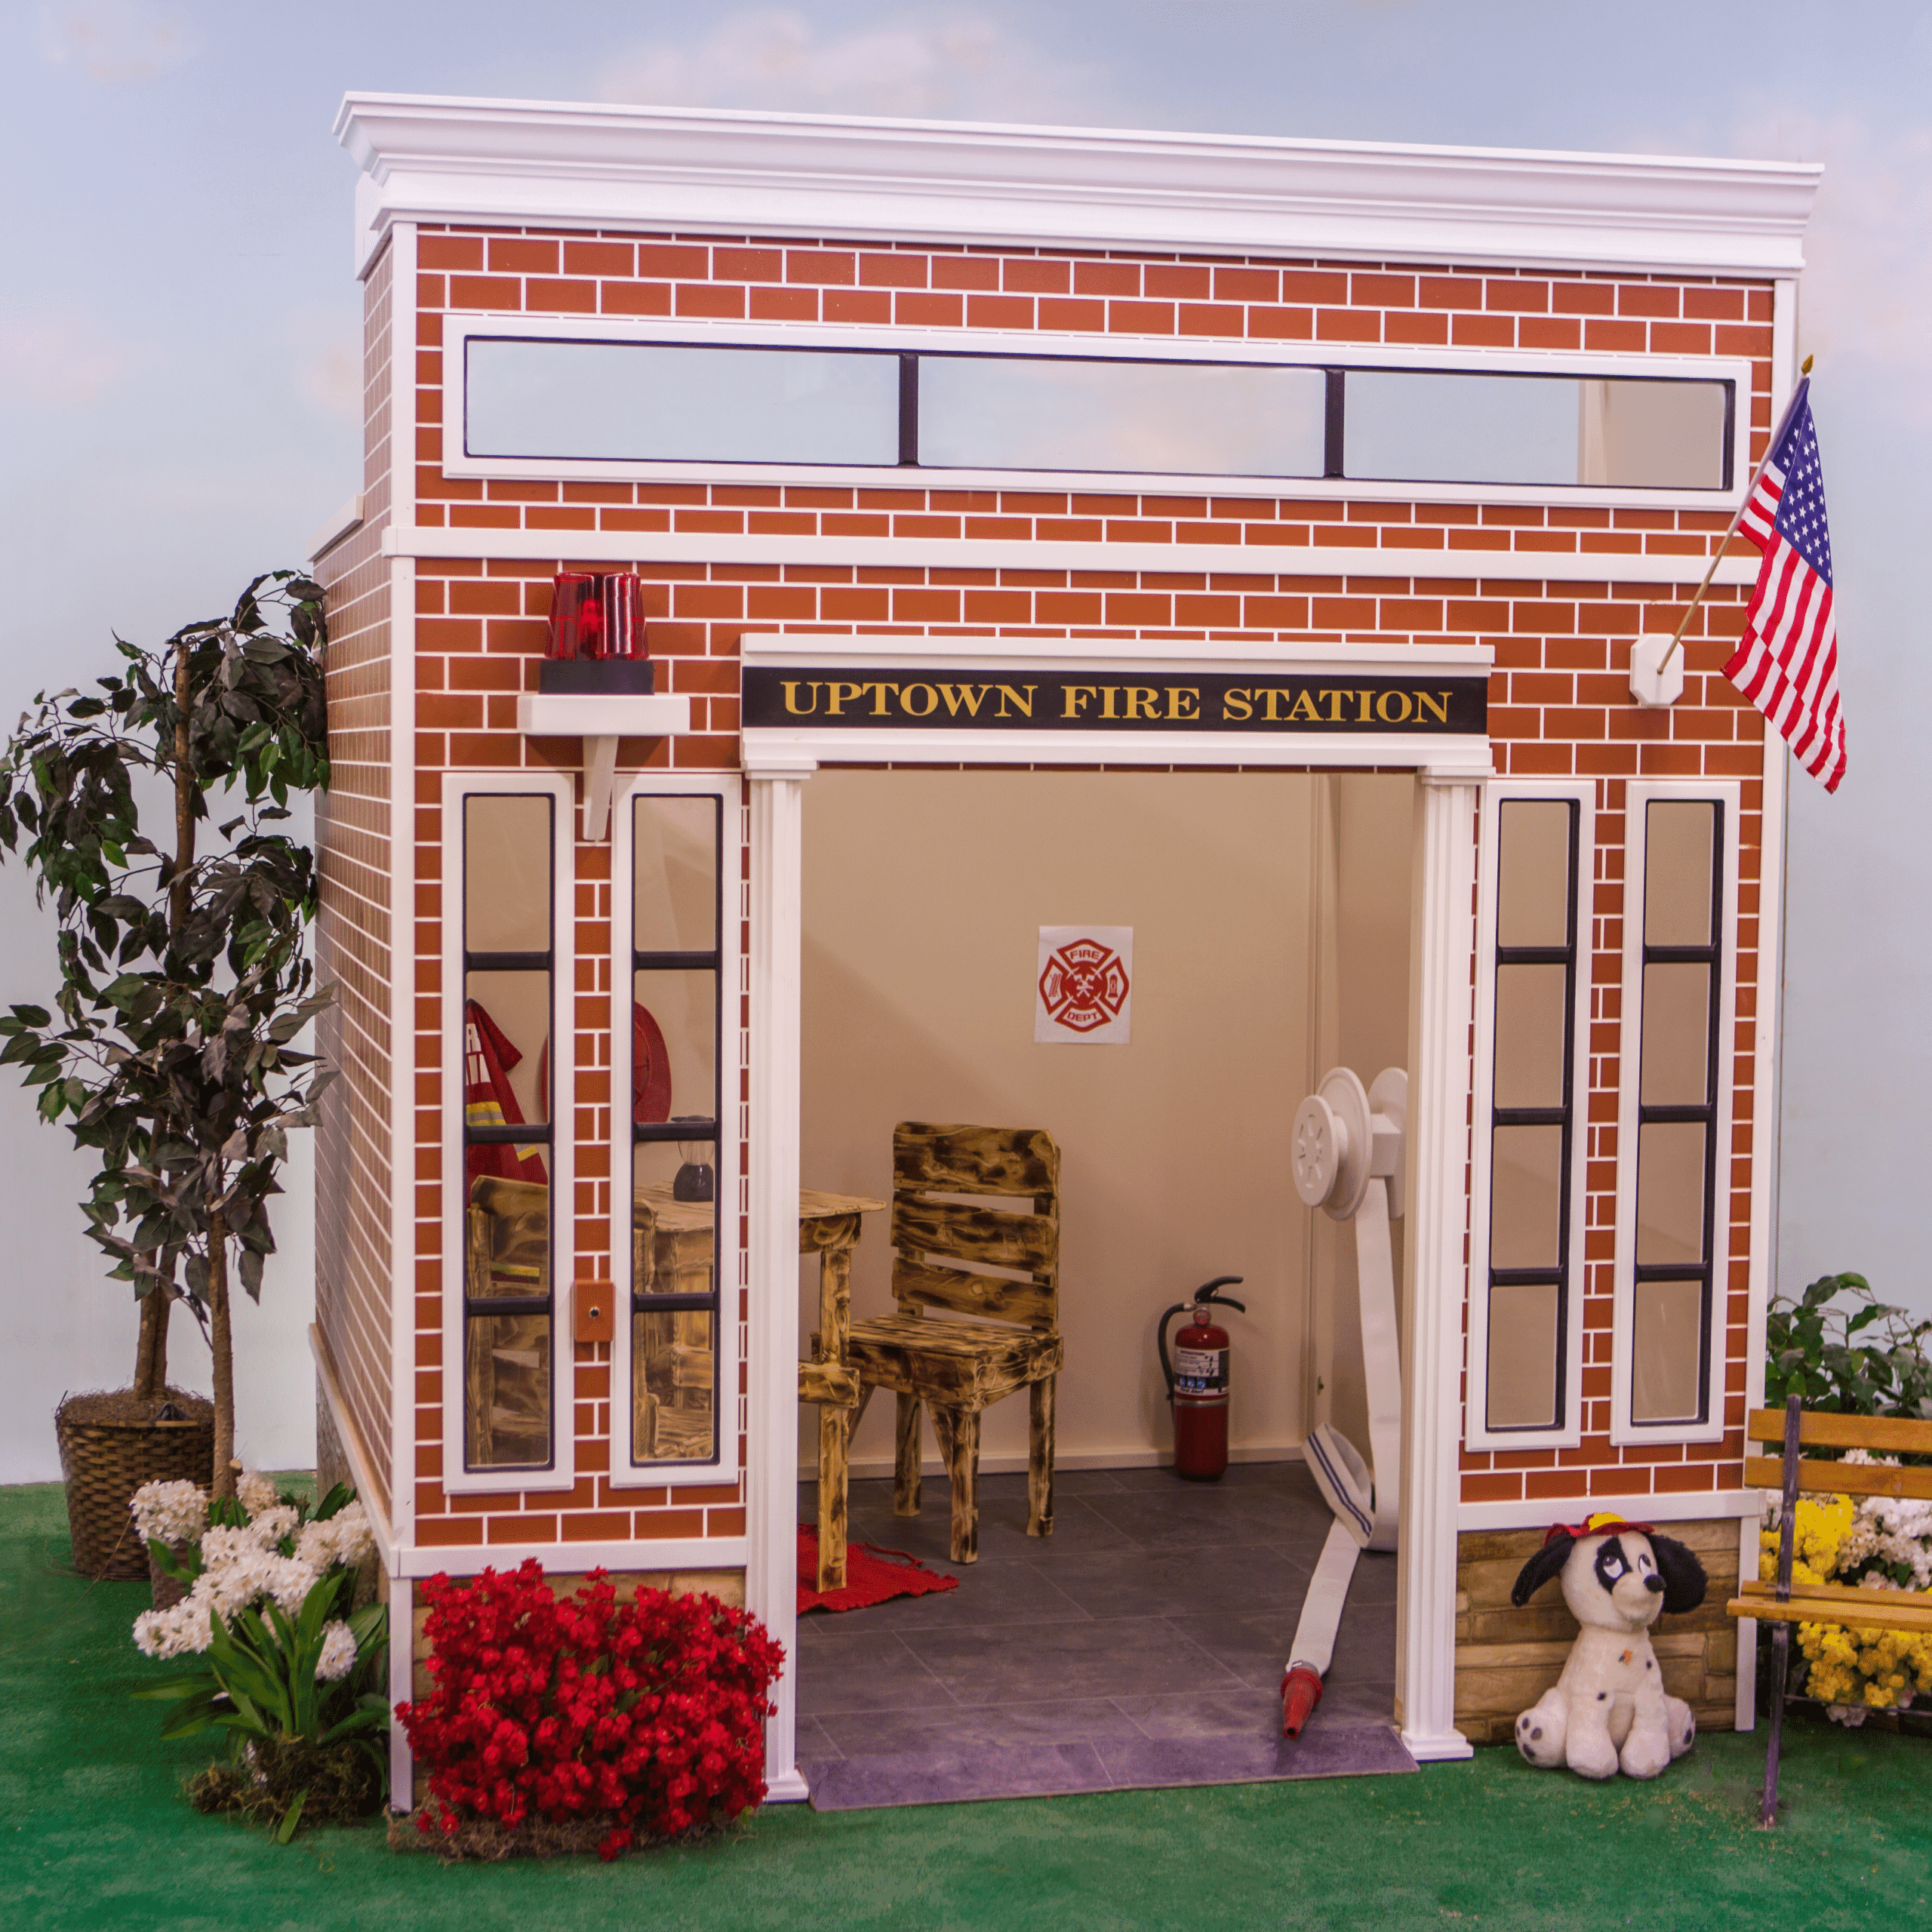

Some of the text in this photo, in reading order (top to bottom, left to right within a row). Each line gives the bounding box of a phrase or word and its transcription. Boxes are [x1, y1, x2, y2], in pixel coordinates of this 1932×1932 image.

[780, 681, 1454, 723] UPTOWN FIRE STATION
[1070, 949, 1100, 960] FIRE
[1067, 1011, 1098, 1022] DEPT
